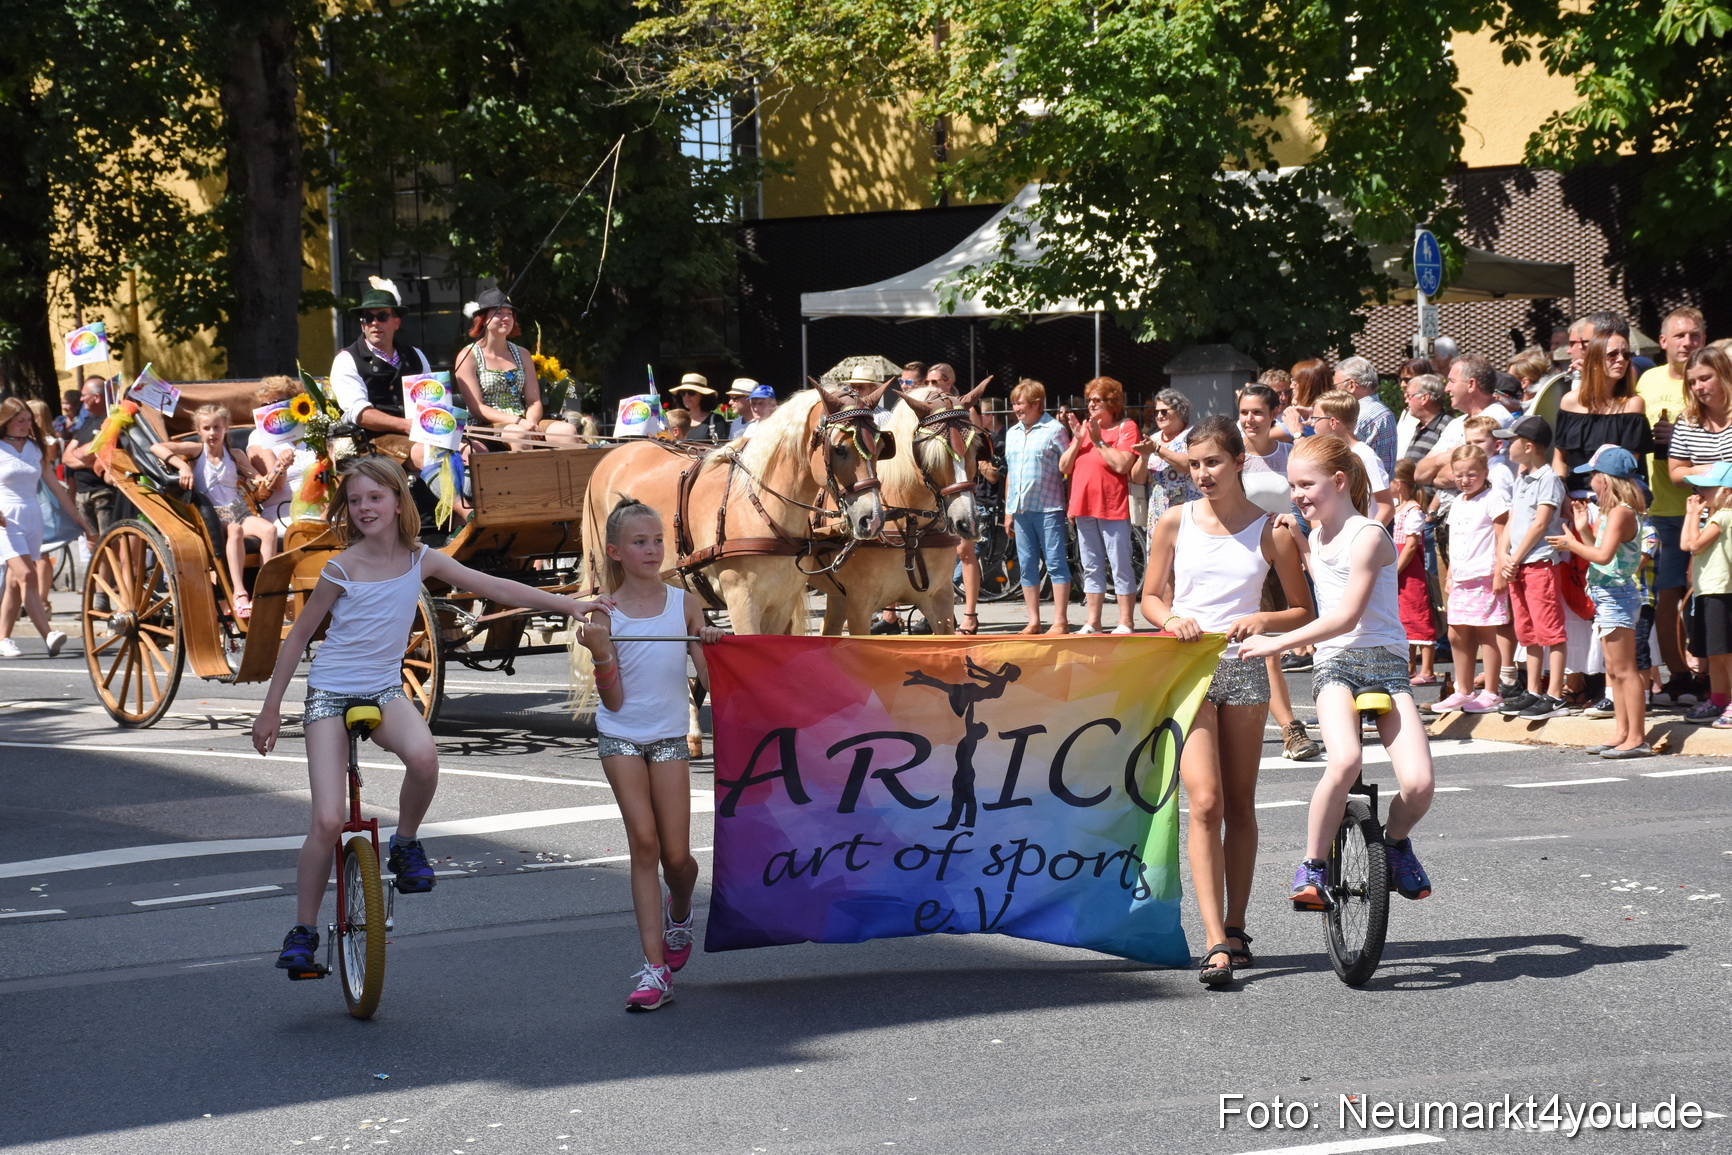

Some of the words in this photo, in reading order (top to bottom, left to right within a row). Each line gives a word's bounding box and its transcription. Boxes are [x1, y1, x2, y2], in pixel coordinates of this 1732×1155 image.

[763, 833, 883, 887] art
[894, 831, 974, 881] of
[982, 837, 1152, 901] sports
